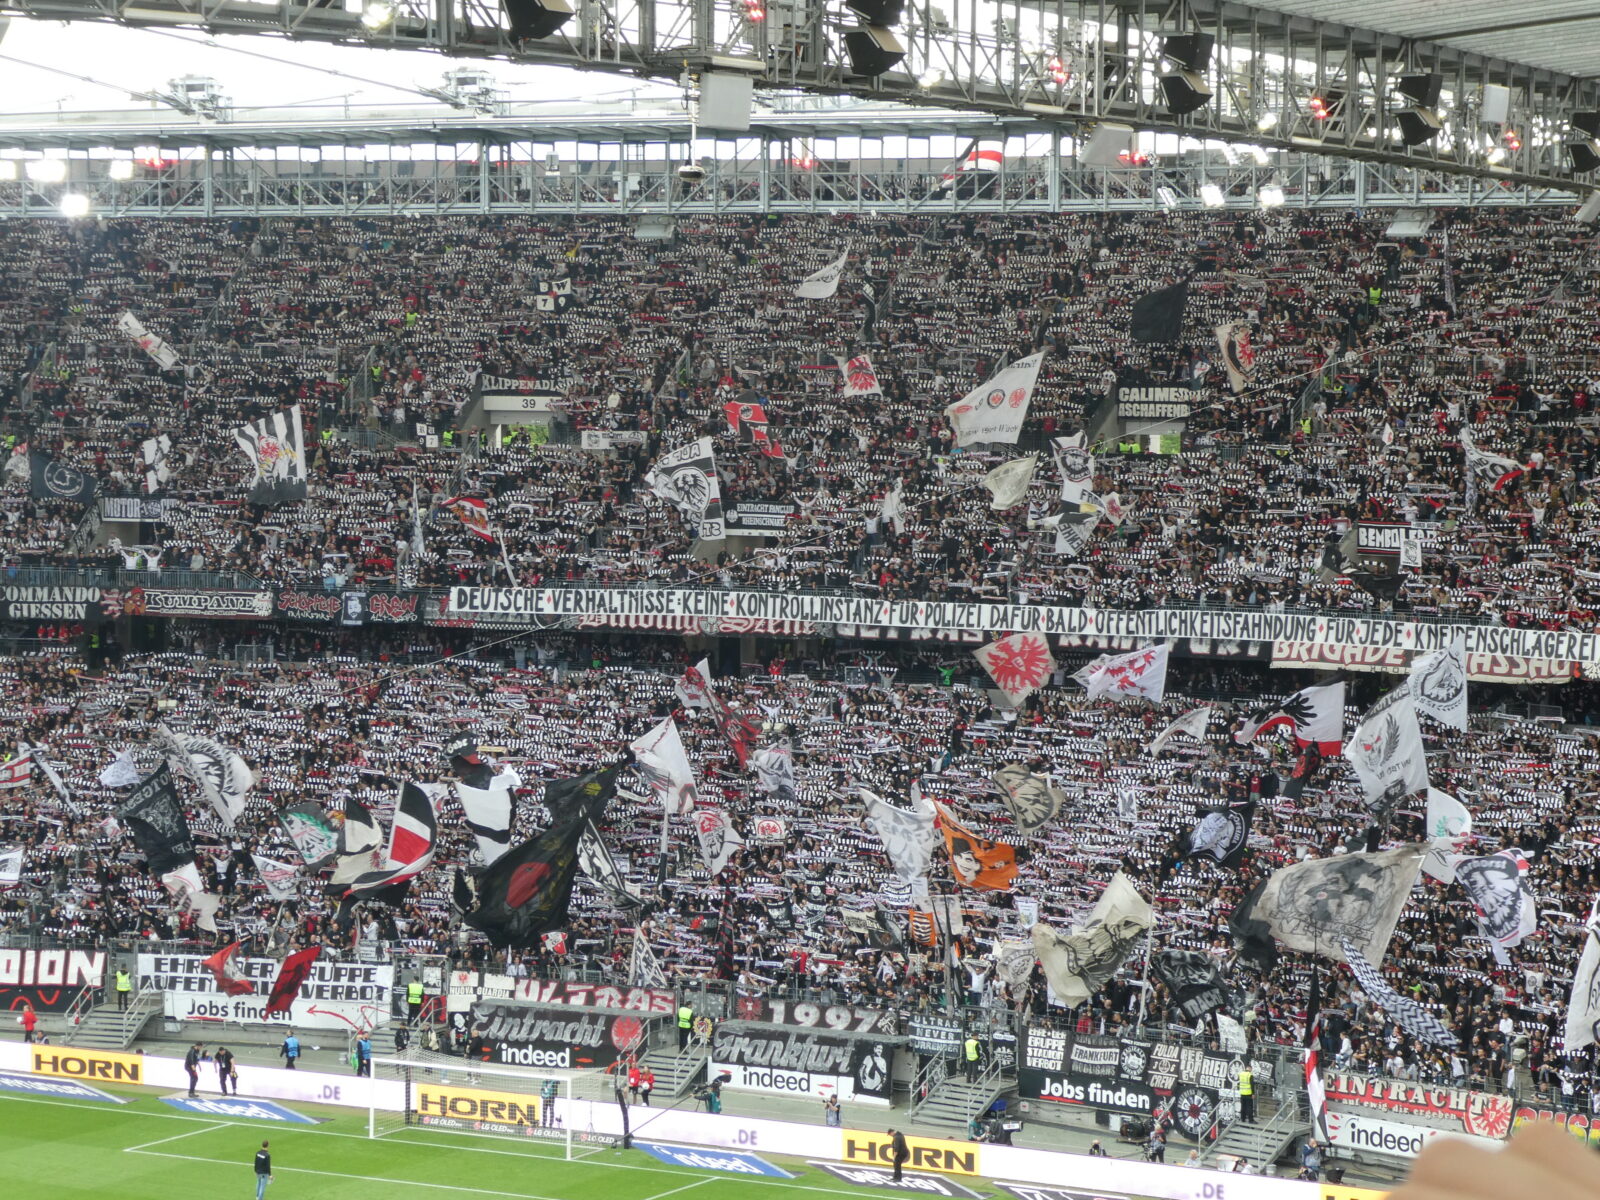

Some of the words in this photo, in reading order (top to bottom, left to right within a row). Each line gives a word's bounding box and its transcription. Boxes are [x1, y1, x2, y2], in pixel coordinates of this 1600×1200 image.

[541, 298, 548, 308] 7
[558, 296, 566, 307] 9
[481, 374, 572, 392] KLIPPENADL
[522, 399, 536, 408] 39
[1118, 403, 1191, 418] ASCHAFFENB
[104, 498, 140, 518] MOTOR
[742, 516, 786, 527] RHEINSCHNAKE
[145, 592, 254, 610] KUMPANE
[369, 593, 419, 619] CREW
[8, 602, 87, 620] GIESSEN
[456, 586, 545, 613] DEUTSCHE
[682, 590, 730, 617] KEINE
[736, 593, 883, 624] KONTROLLINSTANZ
[889, 602, 919, 626] FÜR
[924, 603, 985, 630] POLIZEI,
[990, 606, 1042, 631] DAFÜR
[1046, 608, 1088, 633] BALD
[1325, 618, 1356, 644] FÜR
[1358, 621, 1403, 648] JEDE
[1466, 652, 1577, 680] ASSAU
[307, 964, 378, 983] RUPPE
[449, 986, 474, 995] NUOVA
[476, 986, 510, 998] GUARDIA
[515, 977, 677, 1014] ULTRAS
[187, 998, 230, 1019] Jobs
[768, 1001, 883, 1033] 1997
[471, 1002, 606, 1049] Eintracht
[914, 1015, 959, 1029] ULTRAS
[916, 1028, 955, 1040] NEVER
[712, 1027, 855, 1074] Frankfurt
[1028, 1036, 1066, 1051] GRUPPE
[1152, 1043, 1179, 1058] FULDA
[501, 1042, 571, 1068] indeed
[1026, 1047, 1064, 1061] STADION
[1074, 1047, 1119, 1063] FRANKFURT
[35, 1054, 140, 1081] HORN
[1026, 1056, 1063, 1071] VERBOT
[1202, 1058, 1228, 1078] RIED
[742, 1067, 811, 1094] indeed
[1149, 1075, 1176, 1090] CREW
[1200, 1074, 1227, 1089] GEBIET
[317, 1085, 342, 1101] .DE
[1040, 1077, 1085, 1101] Jobs
[1088, 1083, 1150, 1110] finden
[1323, 1071, 1491, 1114] EINTRACHT
[420, 1092, 540, 1126] HORN
[1342, 1097, 1361, 1107] auf
[1363, 1100, 1390, 1113] ewig
[1391, 1103, 1410, 1114] dir
[1413, 1108, 1457, 1121] ergeben
[430, 1118, 438, 1126] LG
[438, 1119, 457, 1128] OLED
[481, 1123, 489, 1131] LG
[489, 1124, 508, 1134] OLED
[534, 1129, 542, 1137] LG
[542, 1130, 561, 1139] OLED
[732, 1128, 758, 1145] .DE
[1351, 1122, 1424, 1154] indeed
